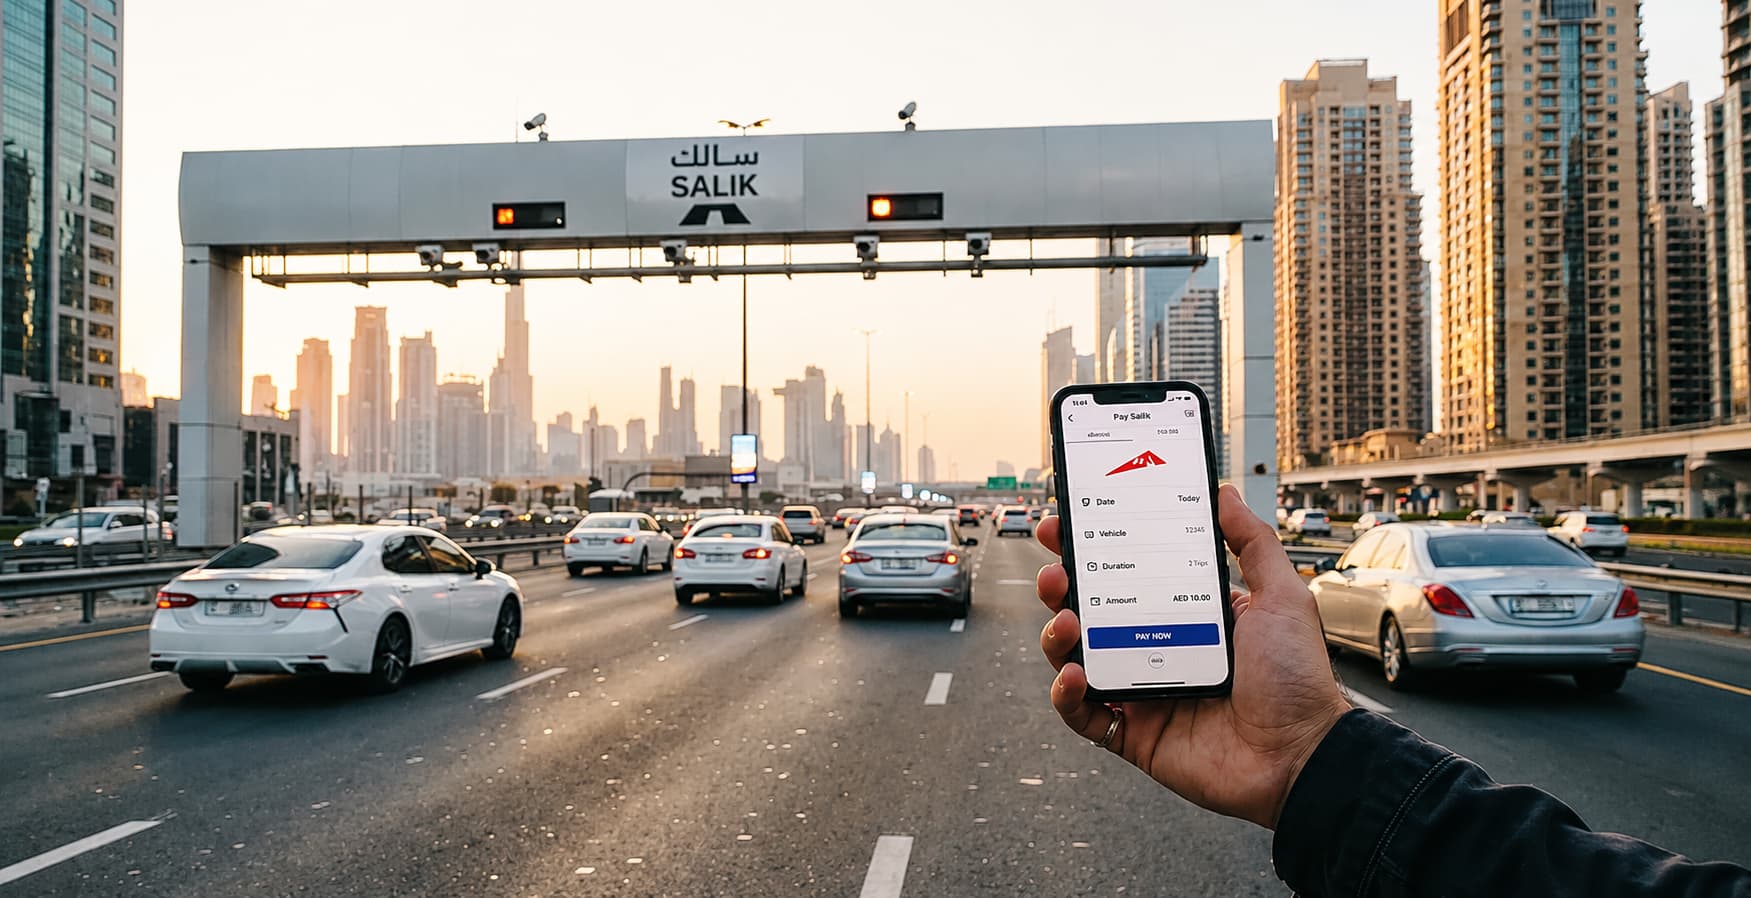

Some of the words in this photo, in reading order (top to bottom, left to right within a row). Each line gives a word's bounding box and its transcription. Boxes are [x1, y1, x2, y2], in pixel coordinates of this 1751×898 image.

[671, 144, 758, 167] سالك
[671, 174, 758, 198] SALIK
[1113, 413, 1129, 421] Pay
[1130, 412, 1151, 420] Salik
[1178, 495, 1200, 504] Today
[1102, 562, 1135, 570] Duration
[1105, 597, 1137, 605] Amount
[1190, 594, 1211, 602] 10.00
[1152, 632, 1172, 640] NOW
